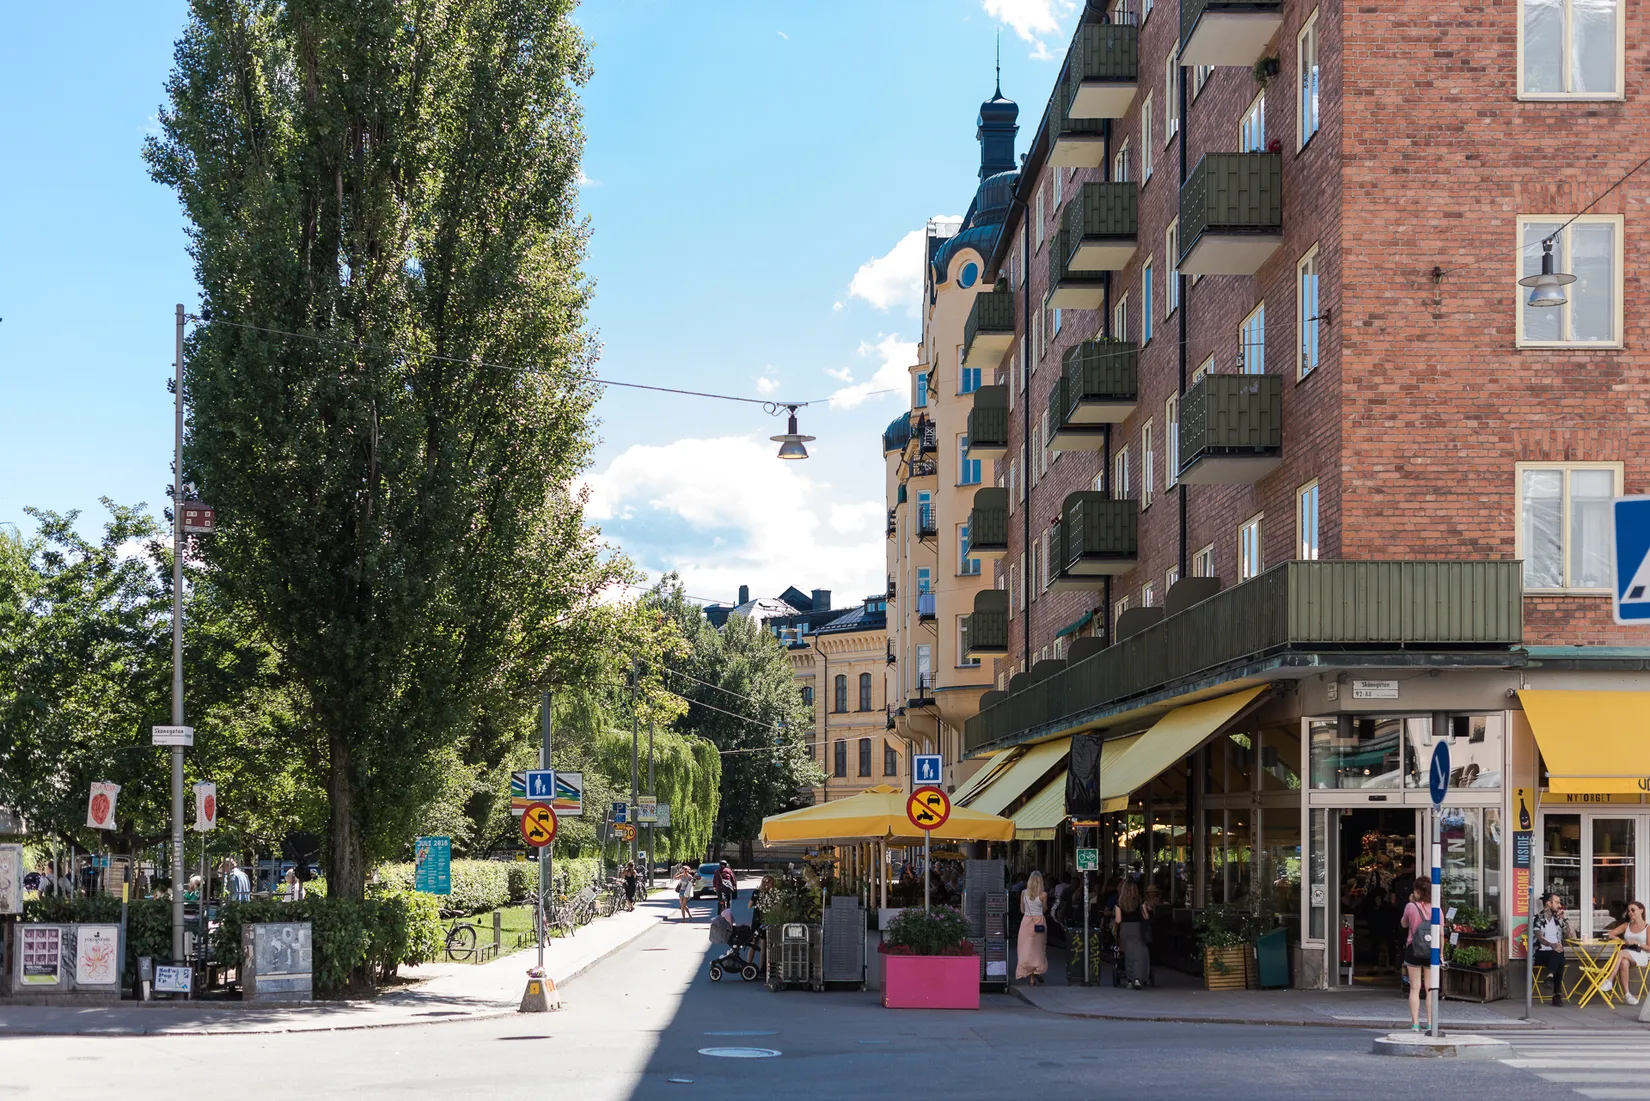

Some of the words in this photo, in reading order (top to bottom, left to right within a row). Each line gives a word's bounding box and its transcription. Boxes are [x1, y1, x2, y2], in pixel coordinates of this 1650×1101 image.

[1567, 793, 1611, 802] NYTORGET
[616, 803, 624, 813] P
[1517, 835, 1529, 864] INSIDE
[1517, 870, 1529, 913] WELCOME
